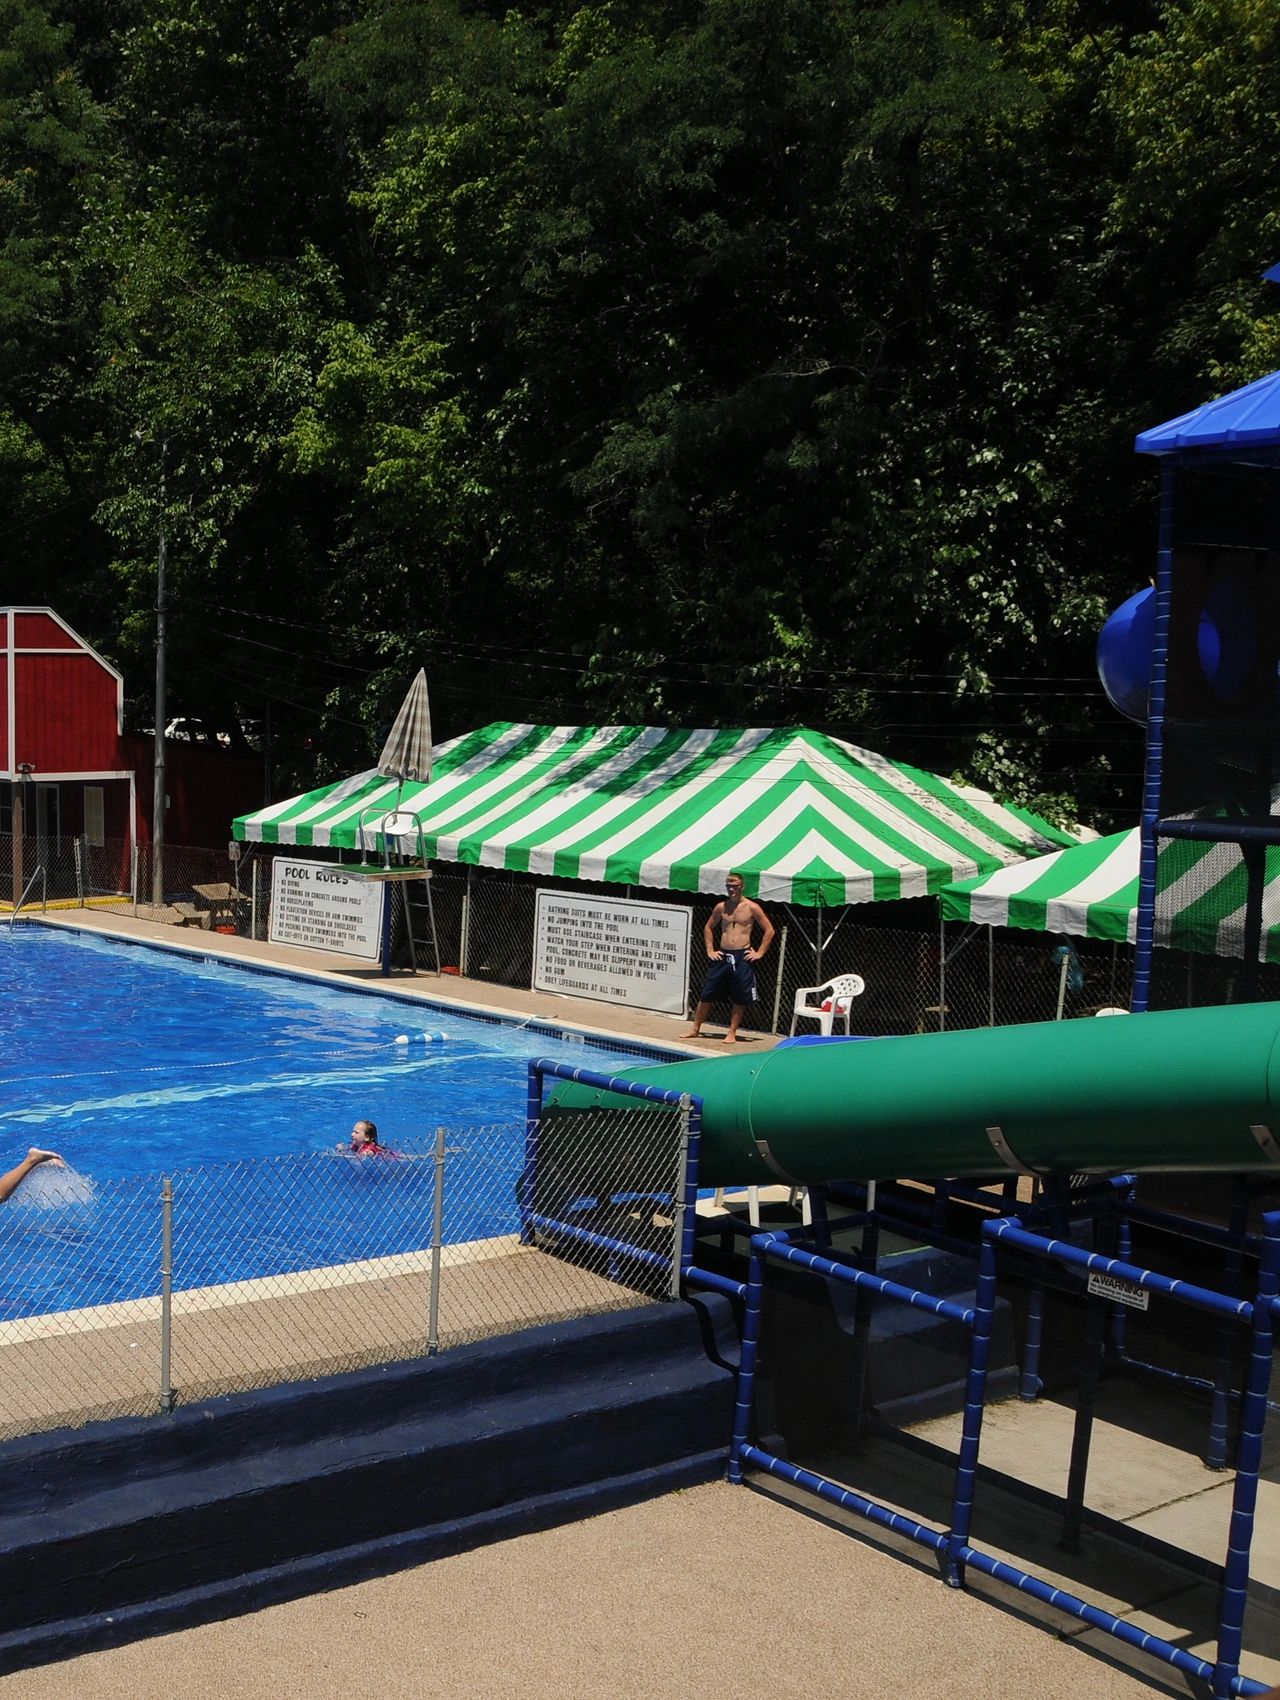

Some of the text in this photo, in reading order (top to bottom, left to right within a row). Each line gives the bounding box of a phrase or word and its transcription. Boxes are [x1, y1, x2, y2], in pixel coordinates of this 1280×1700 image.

[285, 867, 348, 885] POOL RULES
[548, 905, 569, 915] BATHING
[572, 908, 585, 917] SUITS
[588, 911, 602, 919] MUST
[604, 912, 611, 921] BE
[613, 914, 629, 922] WORN
[631, 916, 638, 925] AT
[652, 919, 669, 928] TIMES
[556, 917, 578, 926] JUMPING
[580, 920, 592, 928] INTO
[595, 922, 604, 930] THE
[606, 924, 619, 932] POOL
[547, 926, 677, 951] MUST USE STAIRCASE WHEN ENTERING THE POOL
[547, 936, 677, 962] WATCH YOUR STEP WHEN ENTERING AND EXITING
[554, 957, 567, 965] FOOD
[578, 961, 607, 972] BEVERAGES
[609, 966, 633, 976] ALLOWED
[636, 970, 641, 978] IN
[643, 971, 657, 980] POOL
[562, 948, 587, 959] CONCRETE
[590, 952, 600, 960] MAY
[603, 954, 609, 962] BE
[612, 956, 636, 967] SLIPPERY
[639, 960, 654, 969] WHEN
[656, 962, 668, 971] WET
[554, 967, 564, 975] GUM
[545, 976, 557, 984] OBEY
[559, 978, 589, 990] LIFEGUARDS
[600, 986, 608, 994] ALL
[611, 987, 627, 997] TIMES
[1100, 1275, 1143, 1297] WARNING
